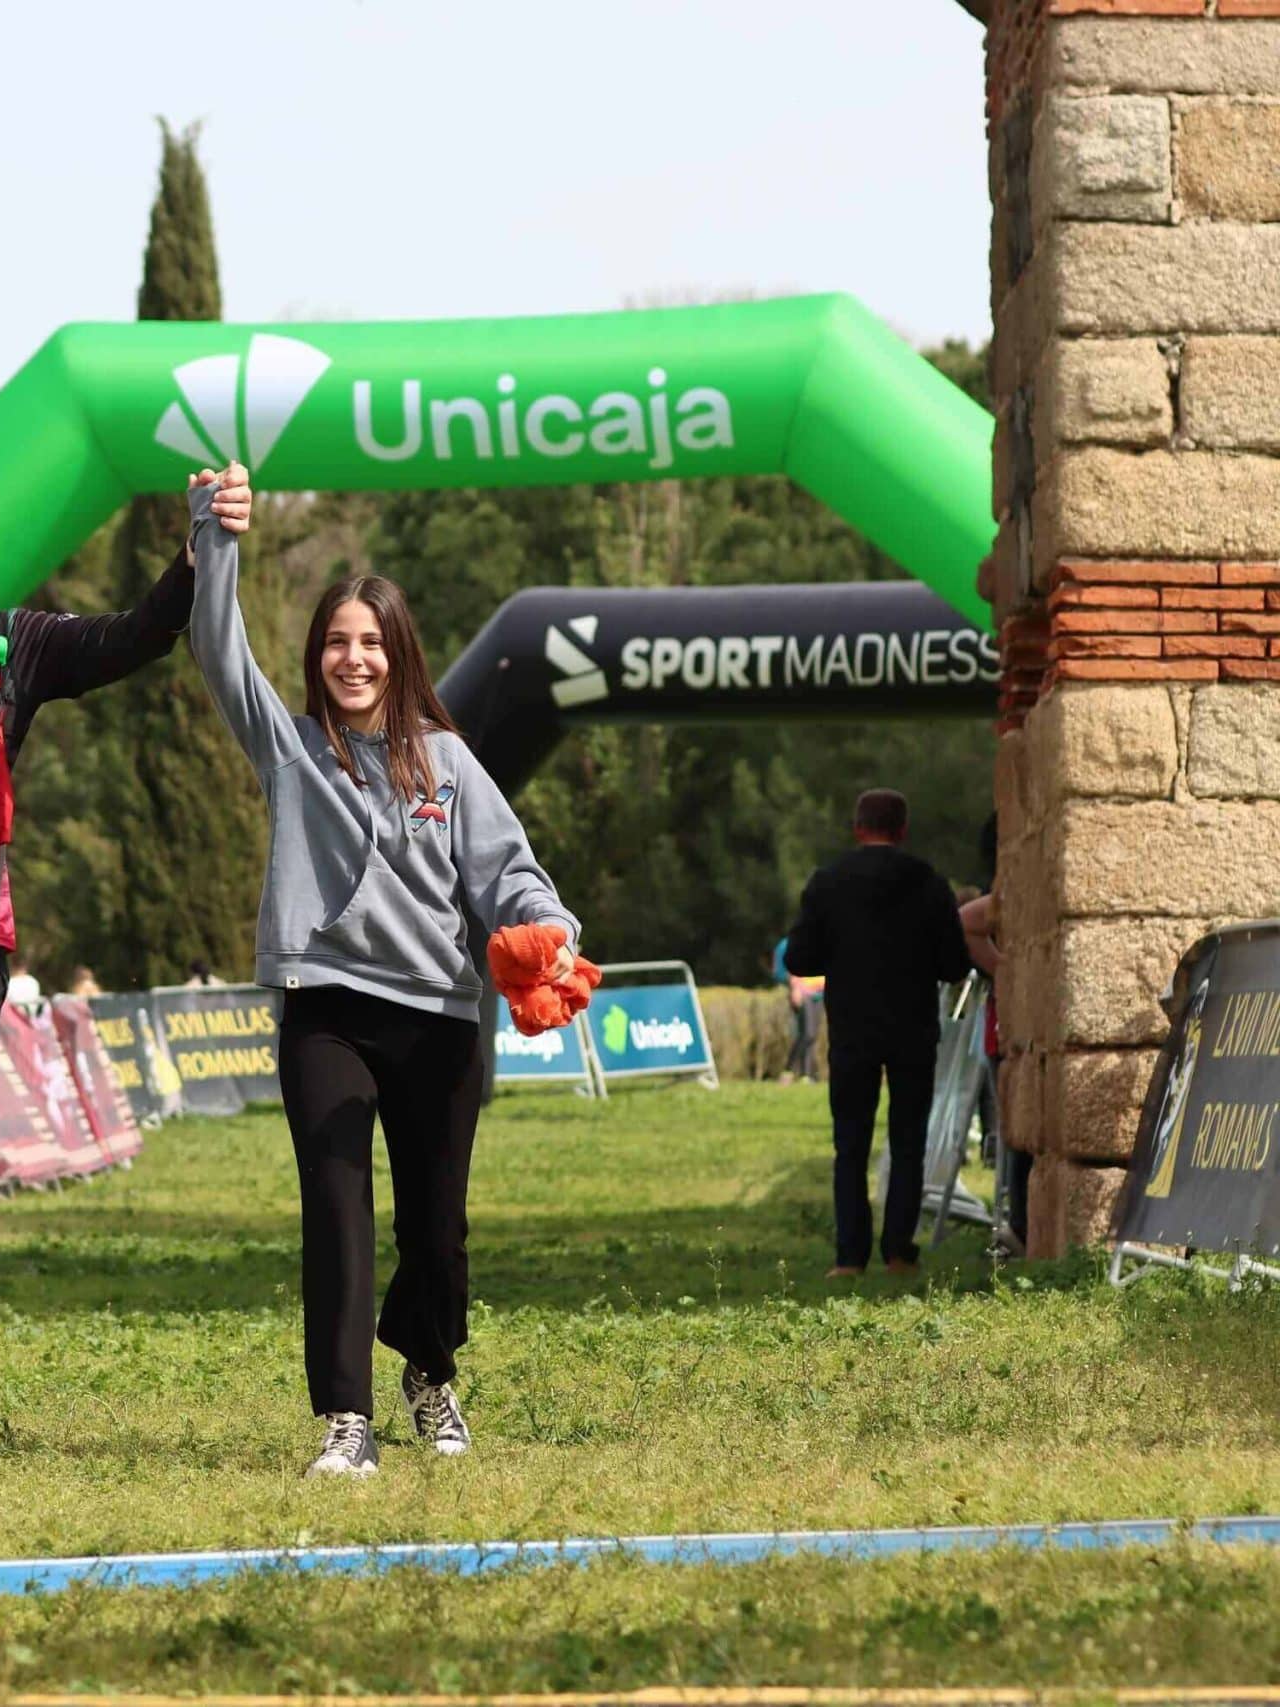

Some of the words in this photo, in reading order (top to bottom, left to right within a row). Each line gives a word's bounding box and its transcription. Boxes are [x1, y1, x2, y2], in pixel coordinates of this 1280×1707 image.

[352, 367, 735, 470] Unicaja
[621, 627, 1005, 692] SPORTMADNESS
[1190, 1102, 1280, 1171] ROMANAS
